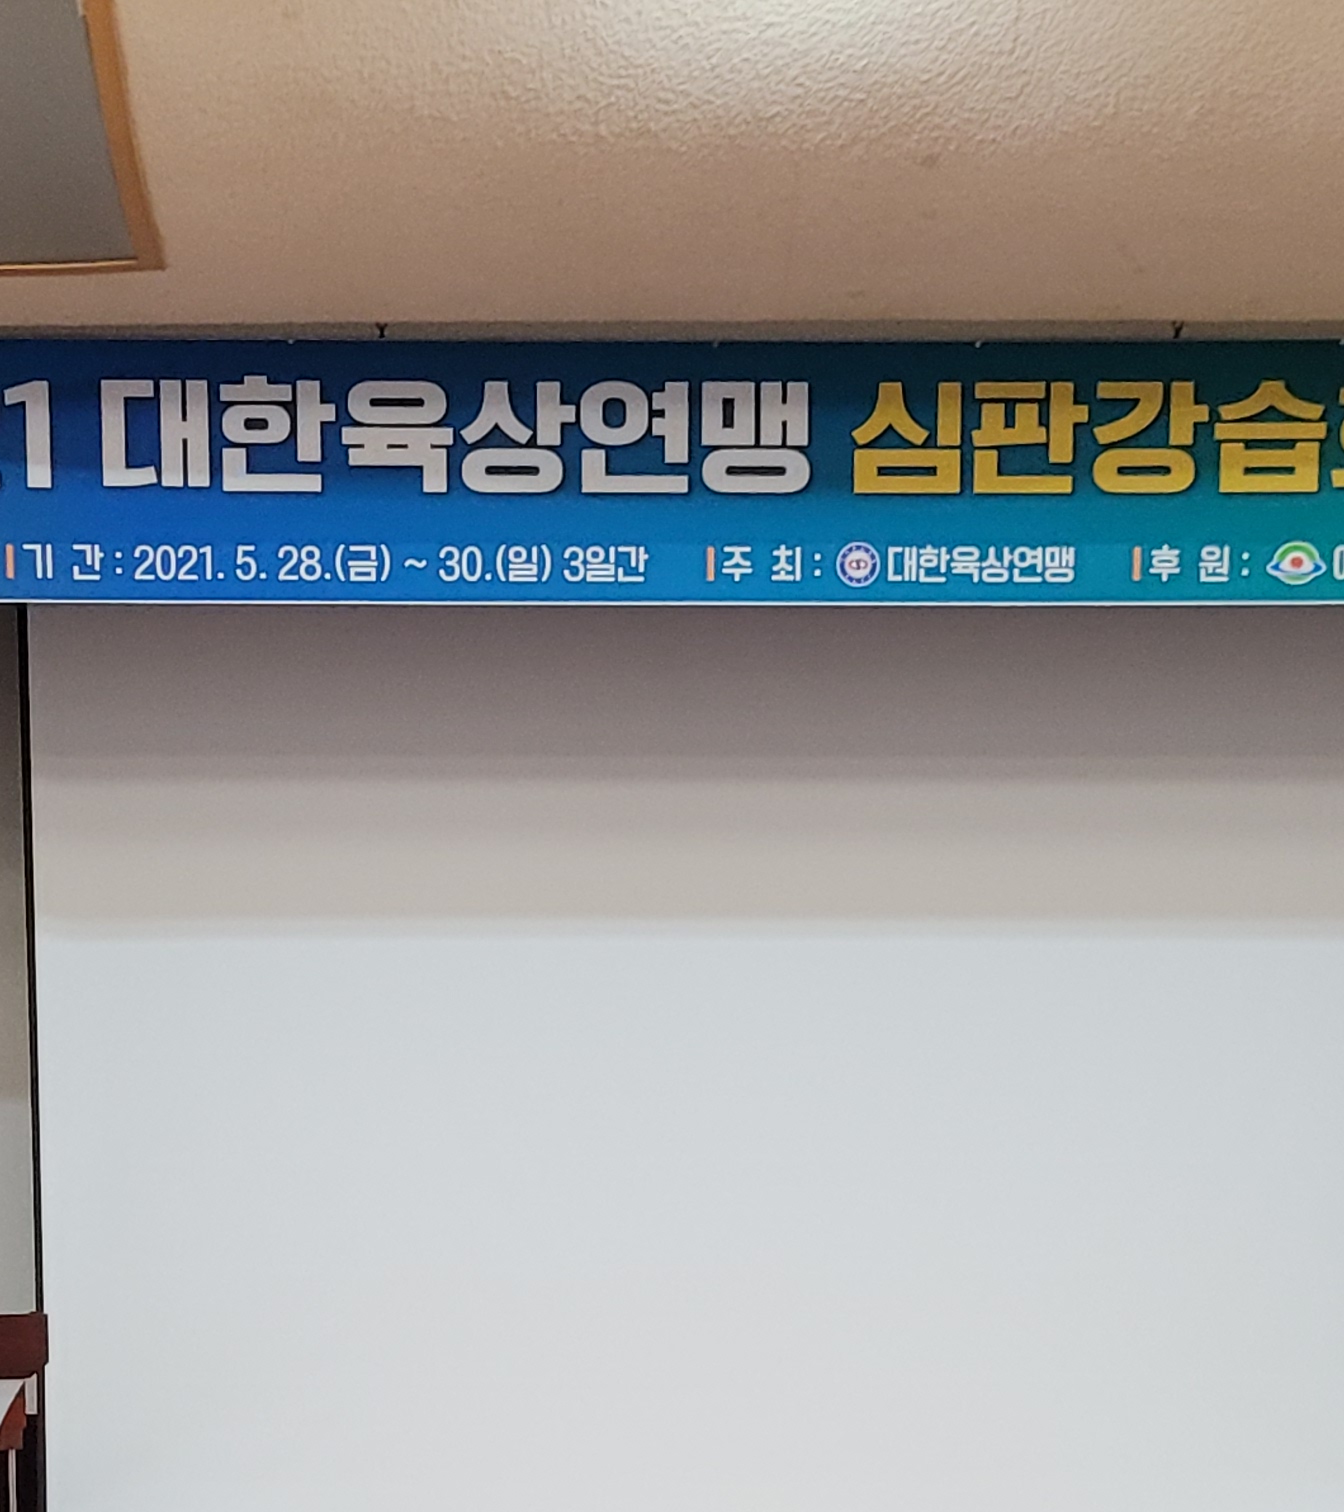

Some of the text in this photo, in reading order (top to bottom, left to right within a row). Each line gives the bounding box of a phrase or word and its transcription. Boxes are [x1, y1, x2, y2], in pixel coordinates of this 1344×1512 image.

[99, 373, 812, 494] 대한육상연맹
[563, 545, 649, 582] 3일간
[887, 545, 1076, 583] 대한육상연맹
